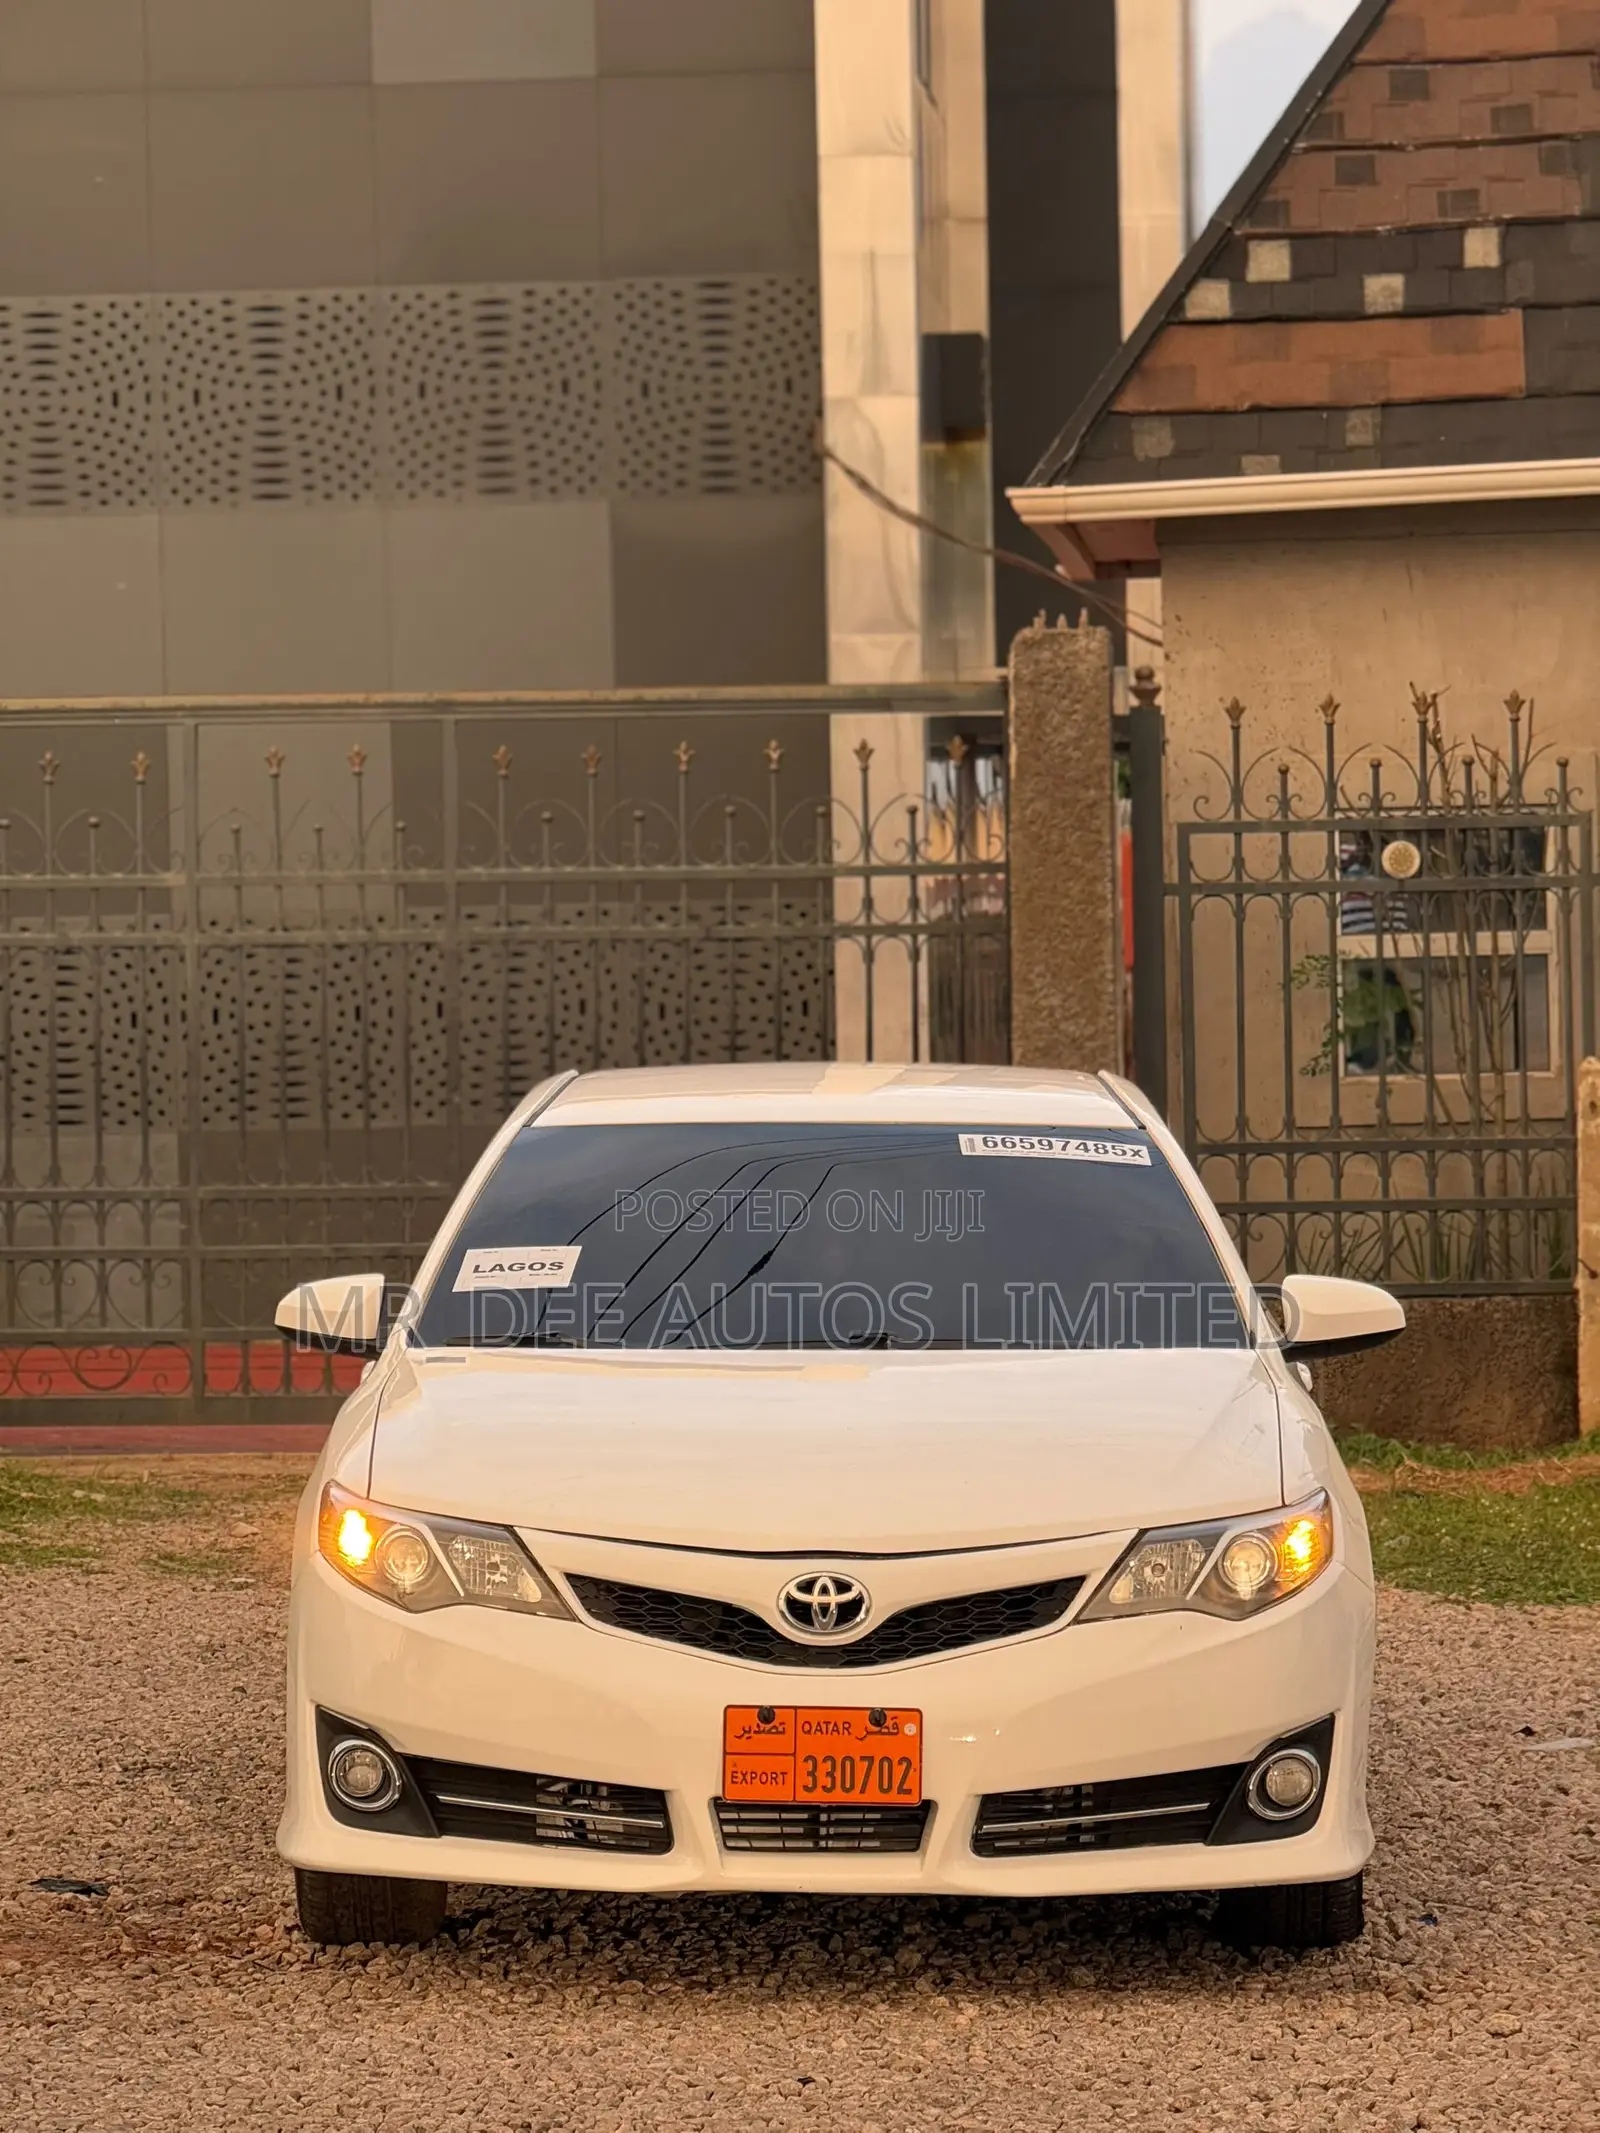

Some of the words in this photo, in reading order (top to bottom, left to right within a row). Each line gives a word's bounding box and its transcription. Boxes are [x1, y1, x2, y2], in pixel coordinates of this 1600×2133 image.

[472, 1261, 564, 1274] LAGOS
[801, 1720, 852, 1736] QATAR
[730, 1771, 788, 1785] EXPORT
[802, 1755, 913, 1795] 330702
